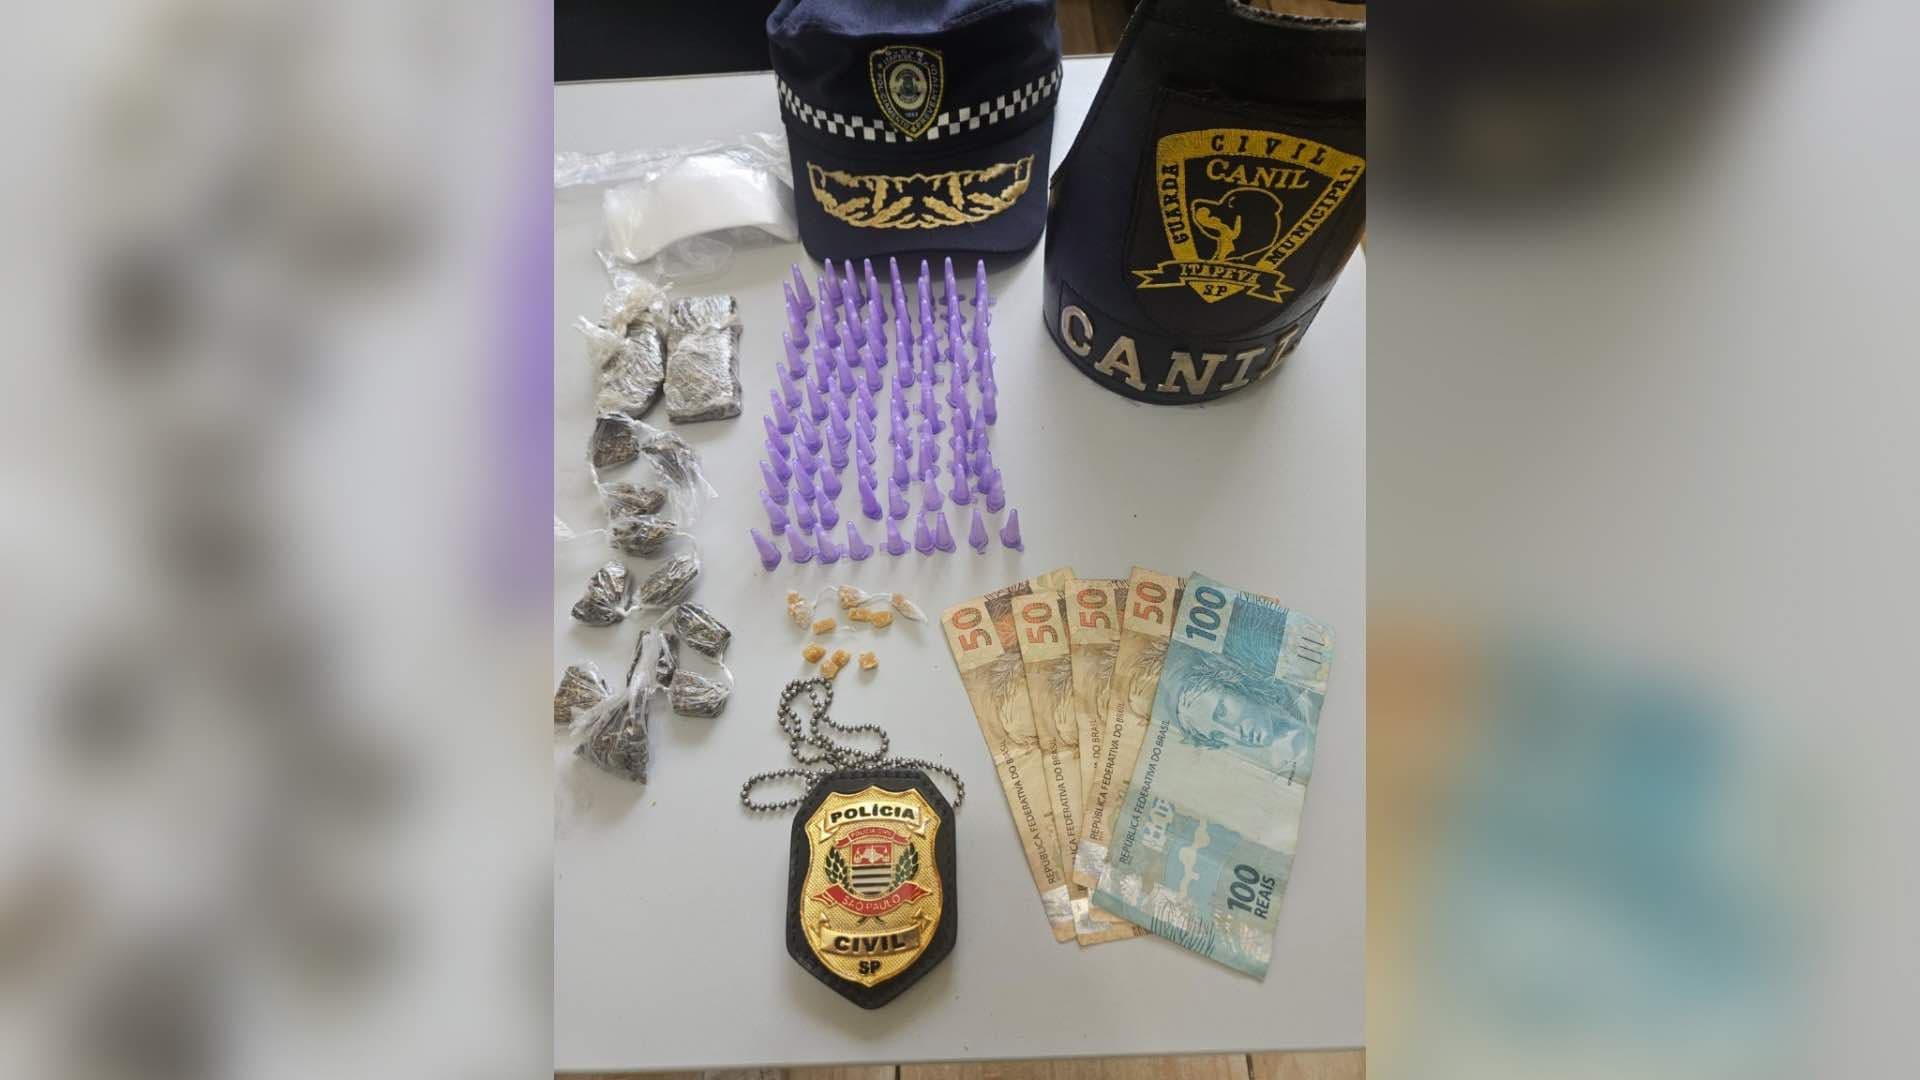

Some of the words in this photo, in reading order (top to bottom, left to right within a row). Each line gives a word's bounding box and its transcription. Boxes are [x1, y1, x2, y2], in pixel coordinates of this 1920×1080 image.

[1211, 134, 1327, 166] CIVIL
[1206, 158, 1310, 190] CANIL
[1161, 164, 1189, 245] GUARDA
[1269, 164, 1360, 265] MUNICIPAL
[1180, 263, 1259, 284] ITAPEVA
[1202, 283, 1228, 297] SP
[1076, 587, 1112, 630] 50
[1132, 580, 1168, 625] 50
[1184, 585, 1228, 643] 100
[951, 606, 993, 651] 50
[1021, 602, 1058, 647] 50
[1092, 744, 1100, 758] DO
[1149, 746, 1162, 762] DO
[1155, 719, 1170, 747] BRASIL
[1007, 764, 1019, 779] DO
[1053, 767, 1064, 781] DO
[1100, 739, 1119, 791] FEDERATIVA
[1112, 723, 1123, 738] DO
[1013, 779, 1038, 832] FEDERATIVA
[1056, 782, 1075, 836] FEDERATIVA
[1133, 761, 1157, 814] FEDERATIVA
[830, 803, 916, 823] POLÍCIA
[1227, 863, 1260, 913] 100
[1254, 875, 1276, 920] REAIS
[833, 935, 905, 952] CIVIL
[858, 960, 881, 975] SP
